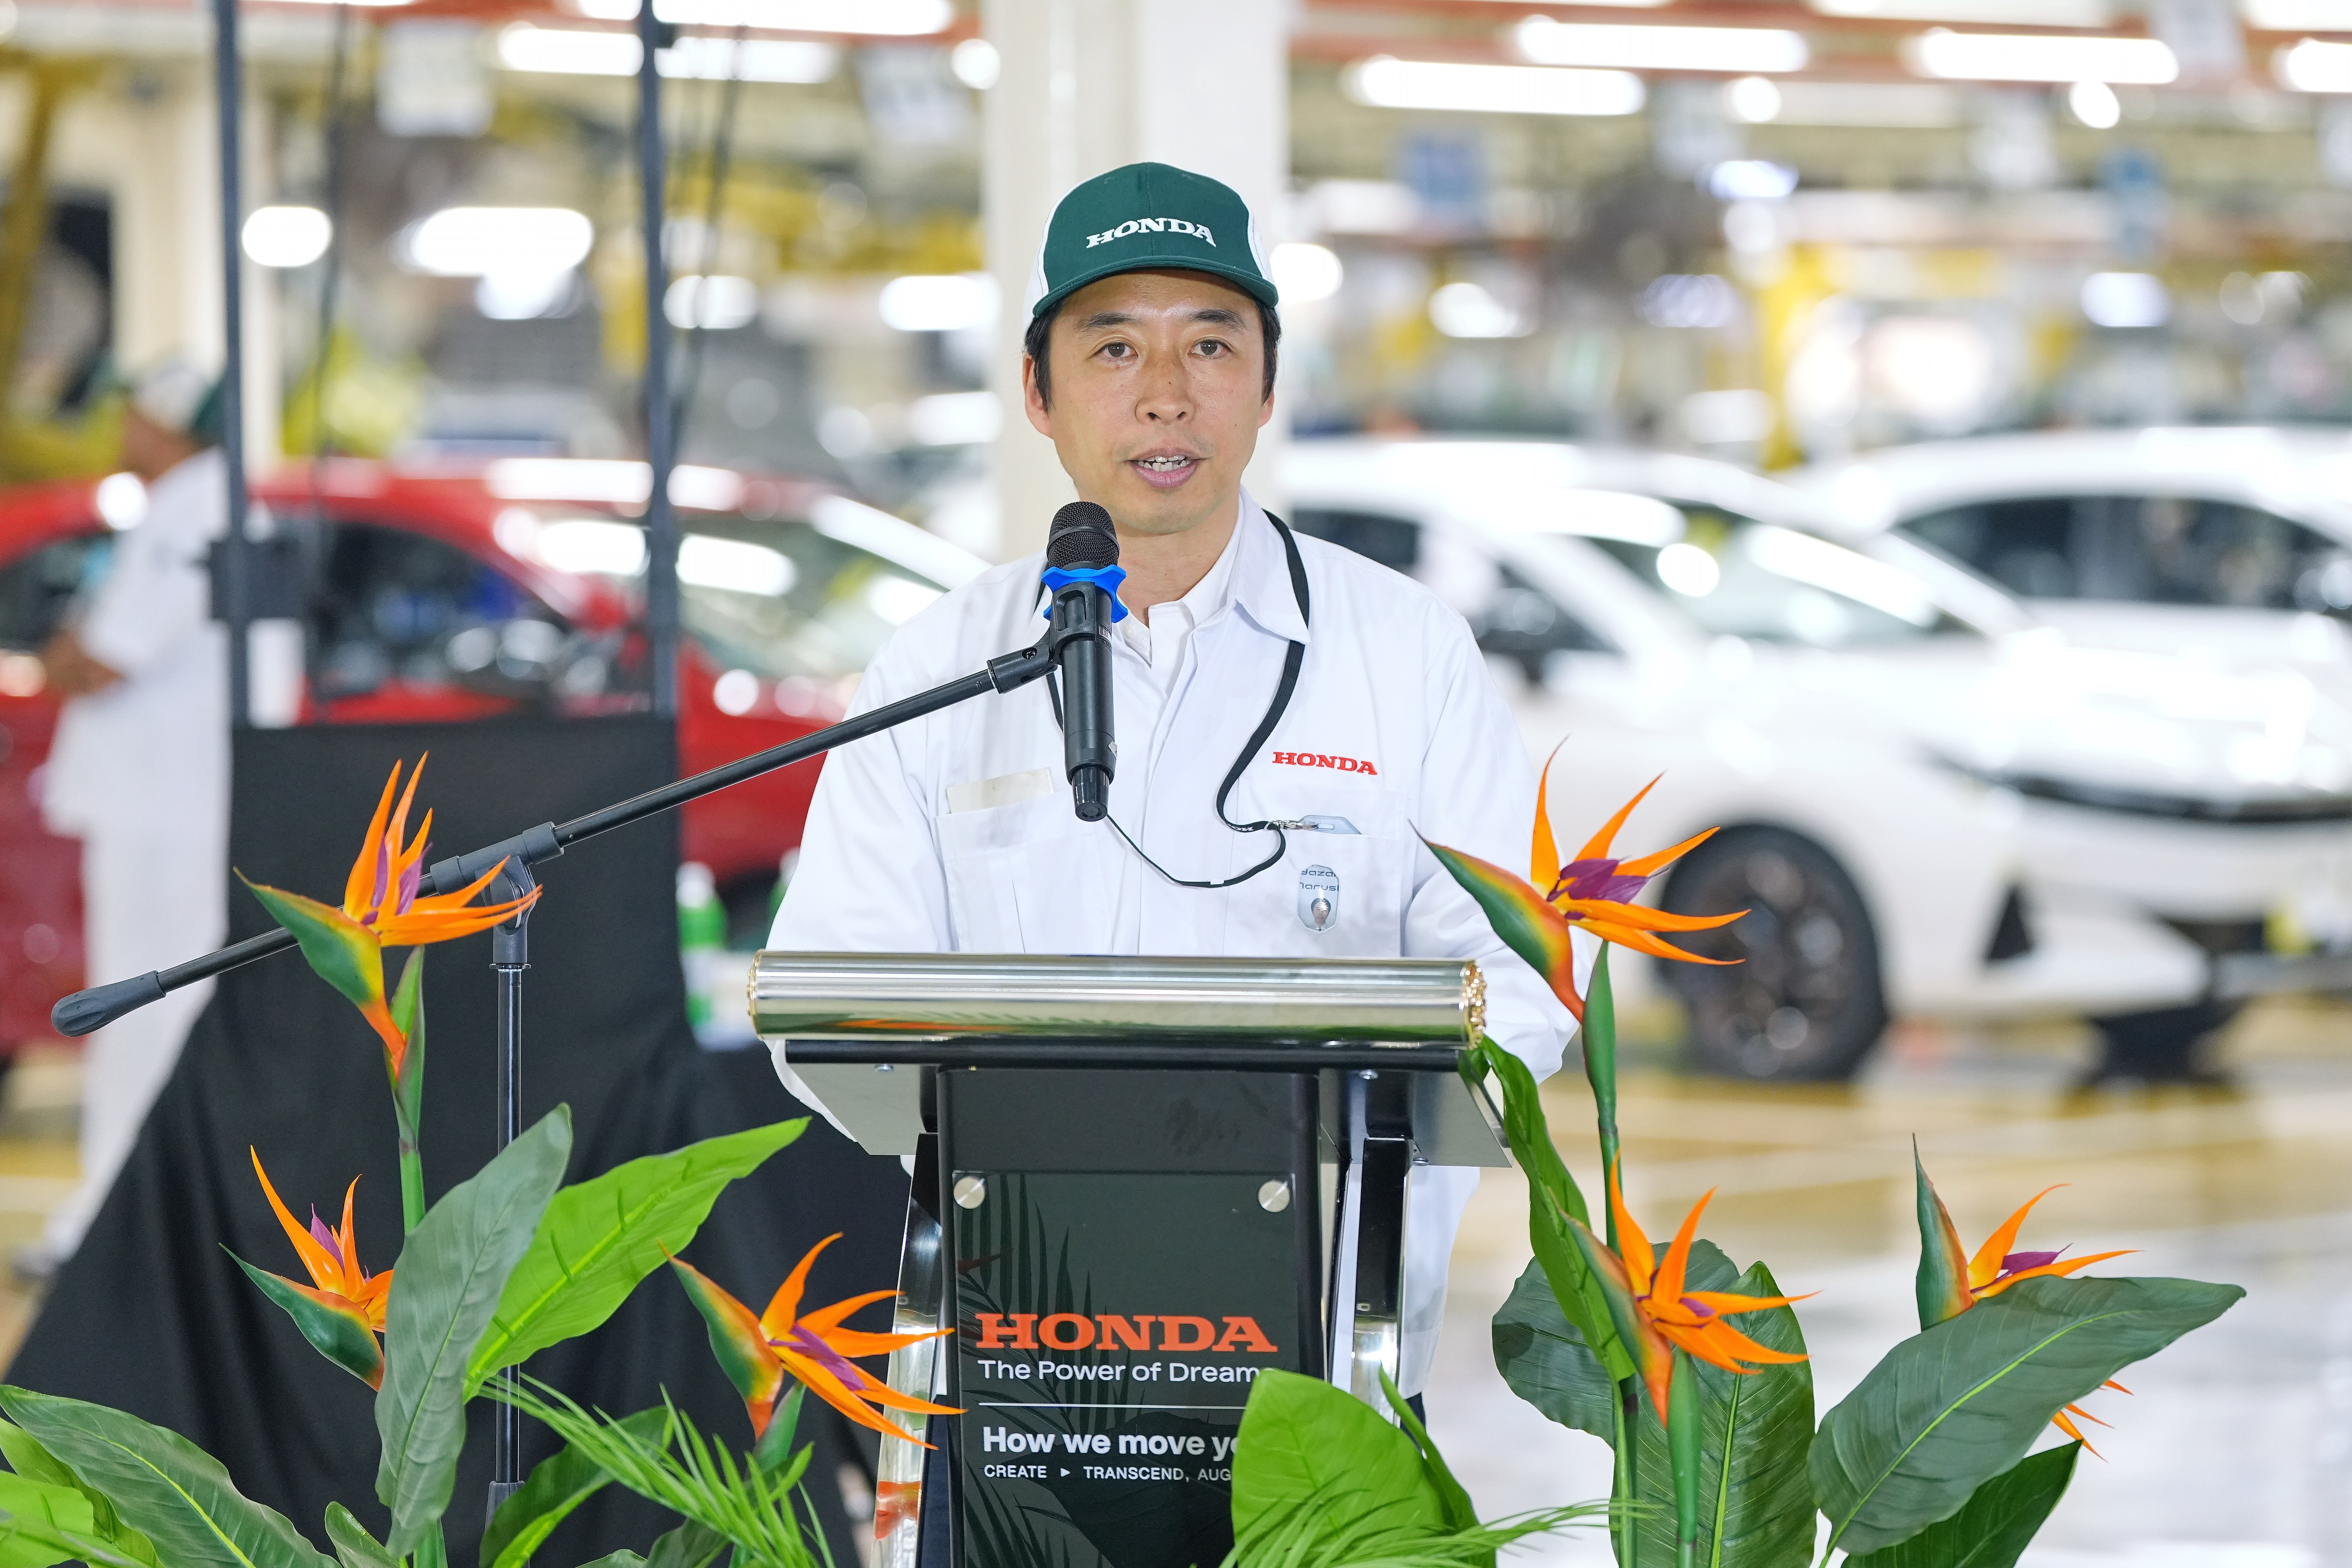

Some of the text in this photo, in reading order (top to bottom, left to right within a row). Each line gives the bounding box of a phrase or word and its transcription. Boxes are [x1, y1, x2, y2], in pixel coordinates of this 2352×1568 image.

[1086, 217, 1217, 248] HONDA
[1272, 751, 1378, 775] HONDA
[975, 1313, 1278, 1352] HONDA
[977, 1359, 1261, 1382] The Power of Dream
[983, 1426, 1056, 1453] How
[1062, 1434, 1112, 1454] we
[1119, 1435, 1206, 1455] move
[984, 1464, 1231, 1482] CREATE TRANSCEND, AUG
